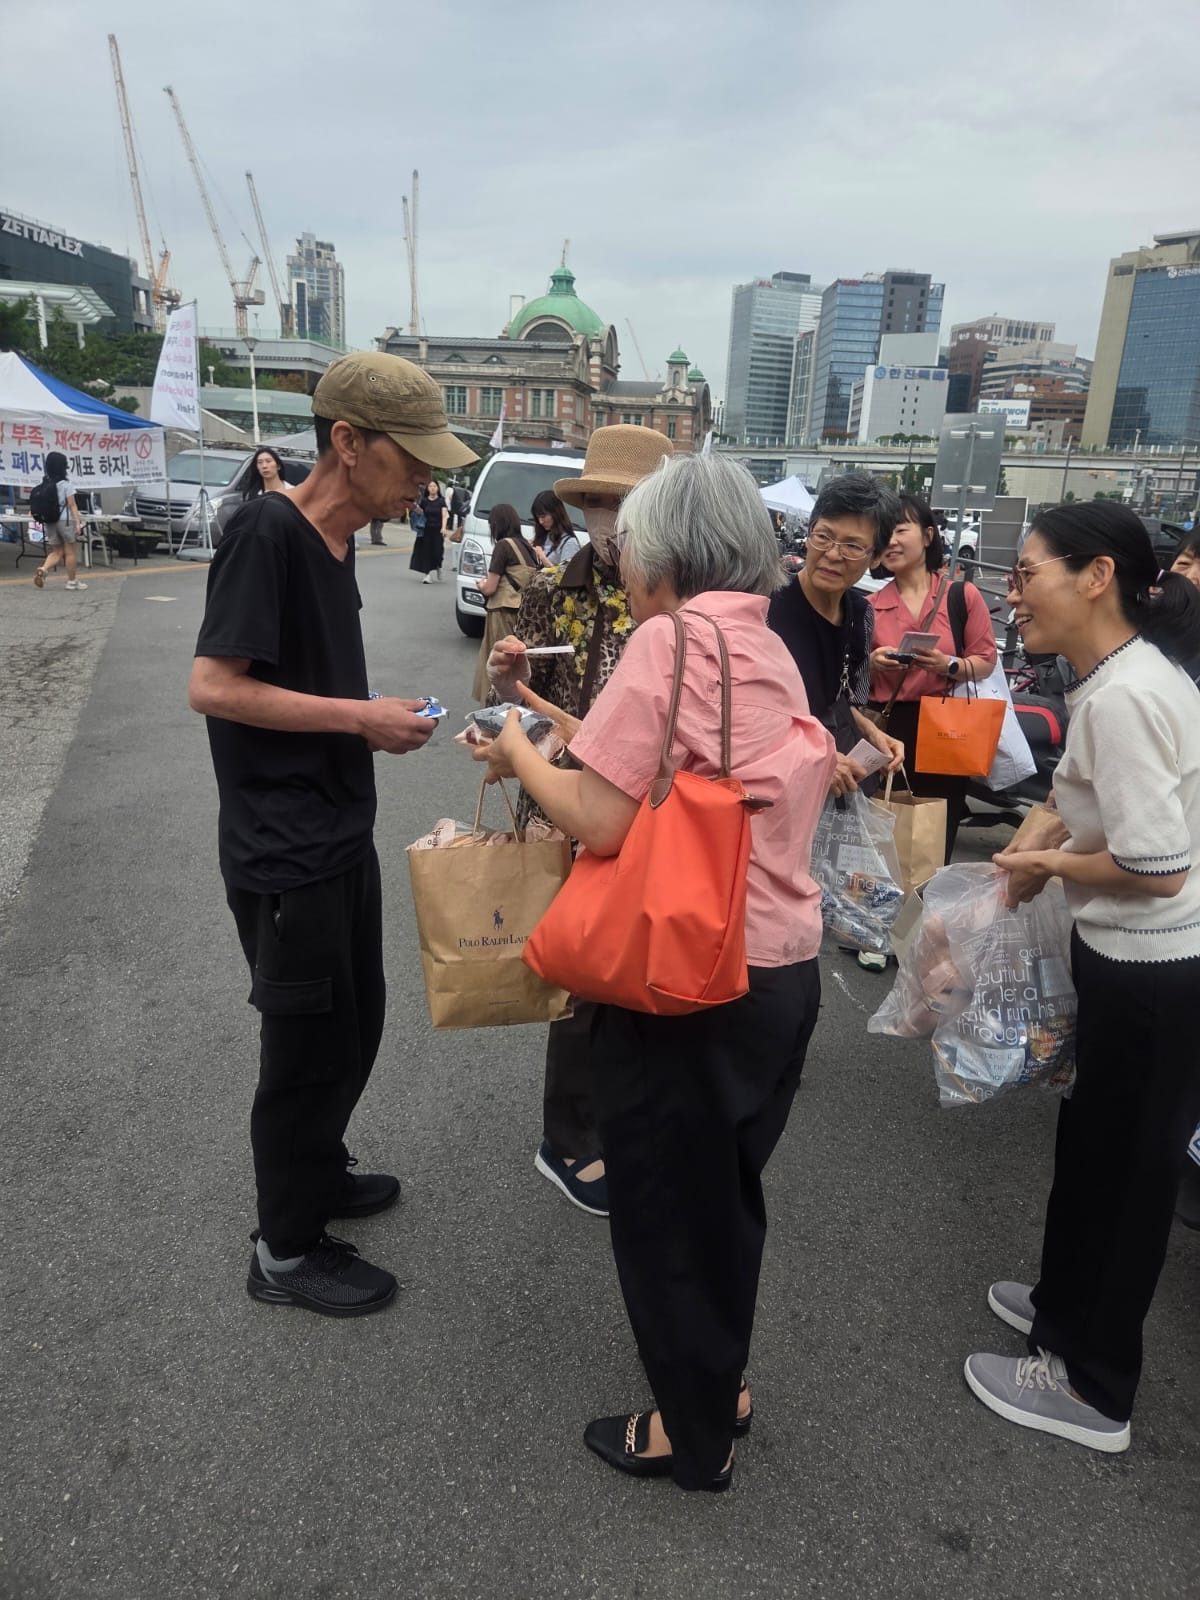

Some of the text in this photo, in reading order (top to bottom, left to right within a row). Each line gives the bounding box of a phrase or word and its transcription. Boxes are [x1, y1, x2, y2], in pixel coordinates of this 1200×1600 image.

[1, 215, 85, 258] ZETTAPLEX
[11, 423, 50, 450] 부족,
[54, 429, 96, 451] 재선거
[98, 433, 131, 452] 하자!
[65, 455, 96, 477] 개표
[98, 455, 131, 477] 하자!
